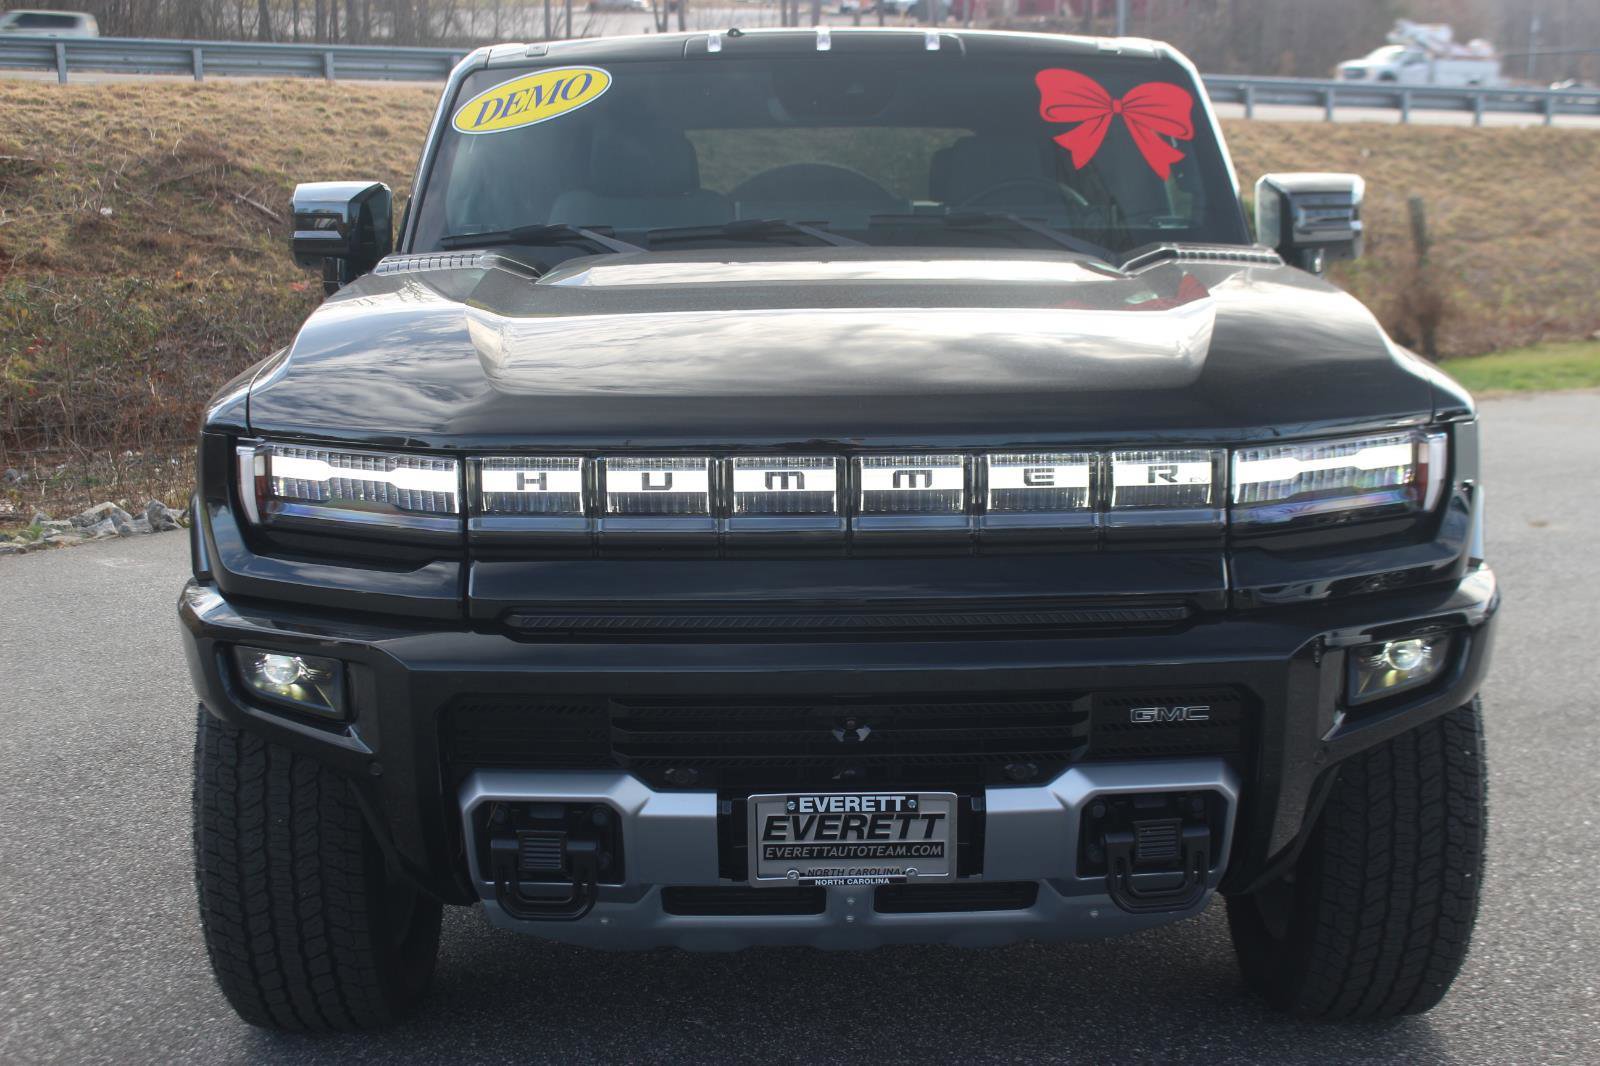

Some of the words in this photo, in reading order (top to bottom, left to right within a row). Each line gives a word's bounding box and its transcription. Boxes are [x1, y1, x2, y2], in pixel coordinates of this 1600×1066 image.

[472, 72, 593, 128] DEMO
[516, 465, 1178, 490] HUMMER
[1130, 705, 1210, 723] GMC
[799, 796, 906, 813] EVERETT
[762, 813, 946, 842] EVERETT
[765, 844, 942, 858] EVERETTAUTOTEAM.COM
[807, 868, 845, 877] NORTH
[848, 867, 900, 876] CAROLINA
